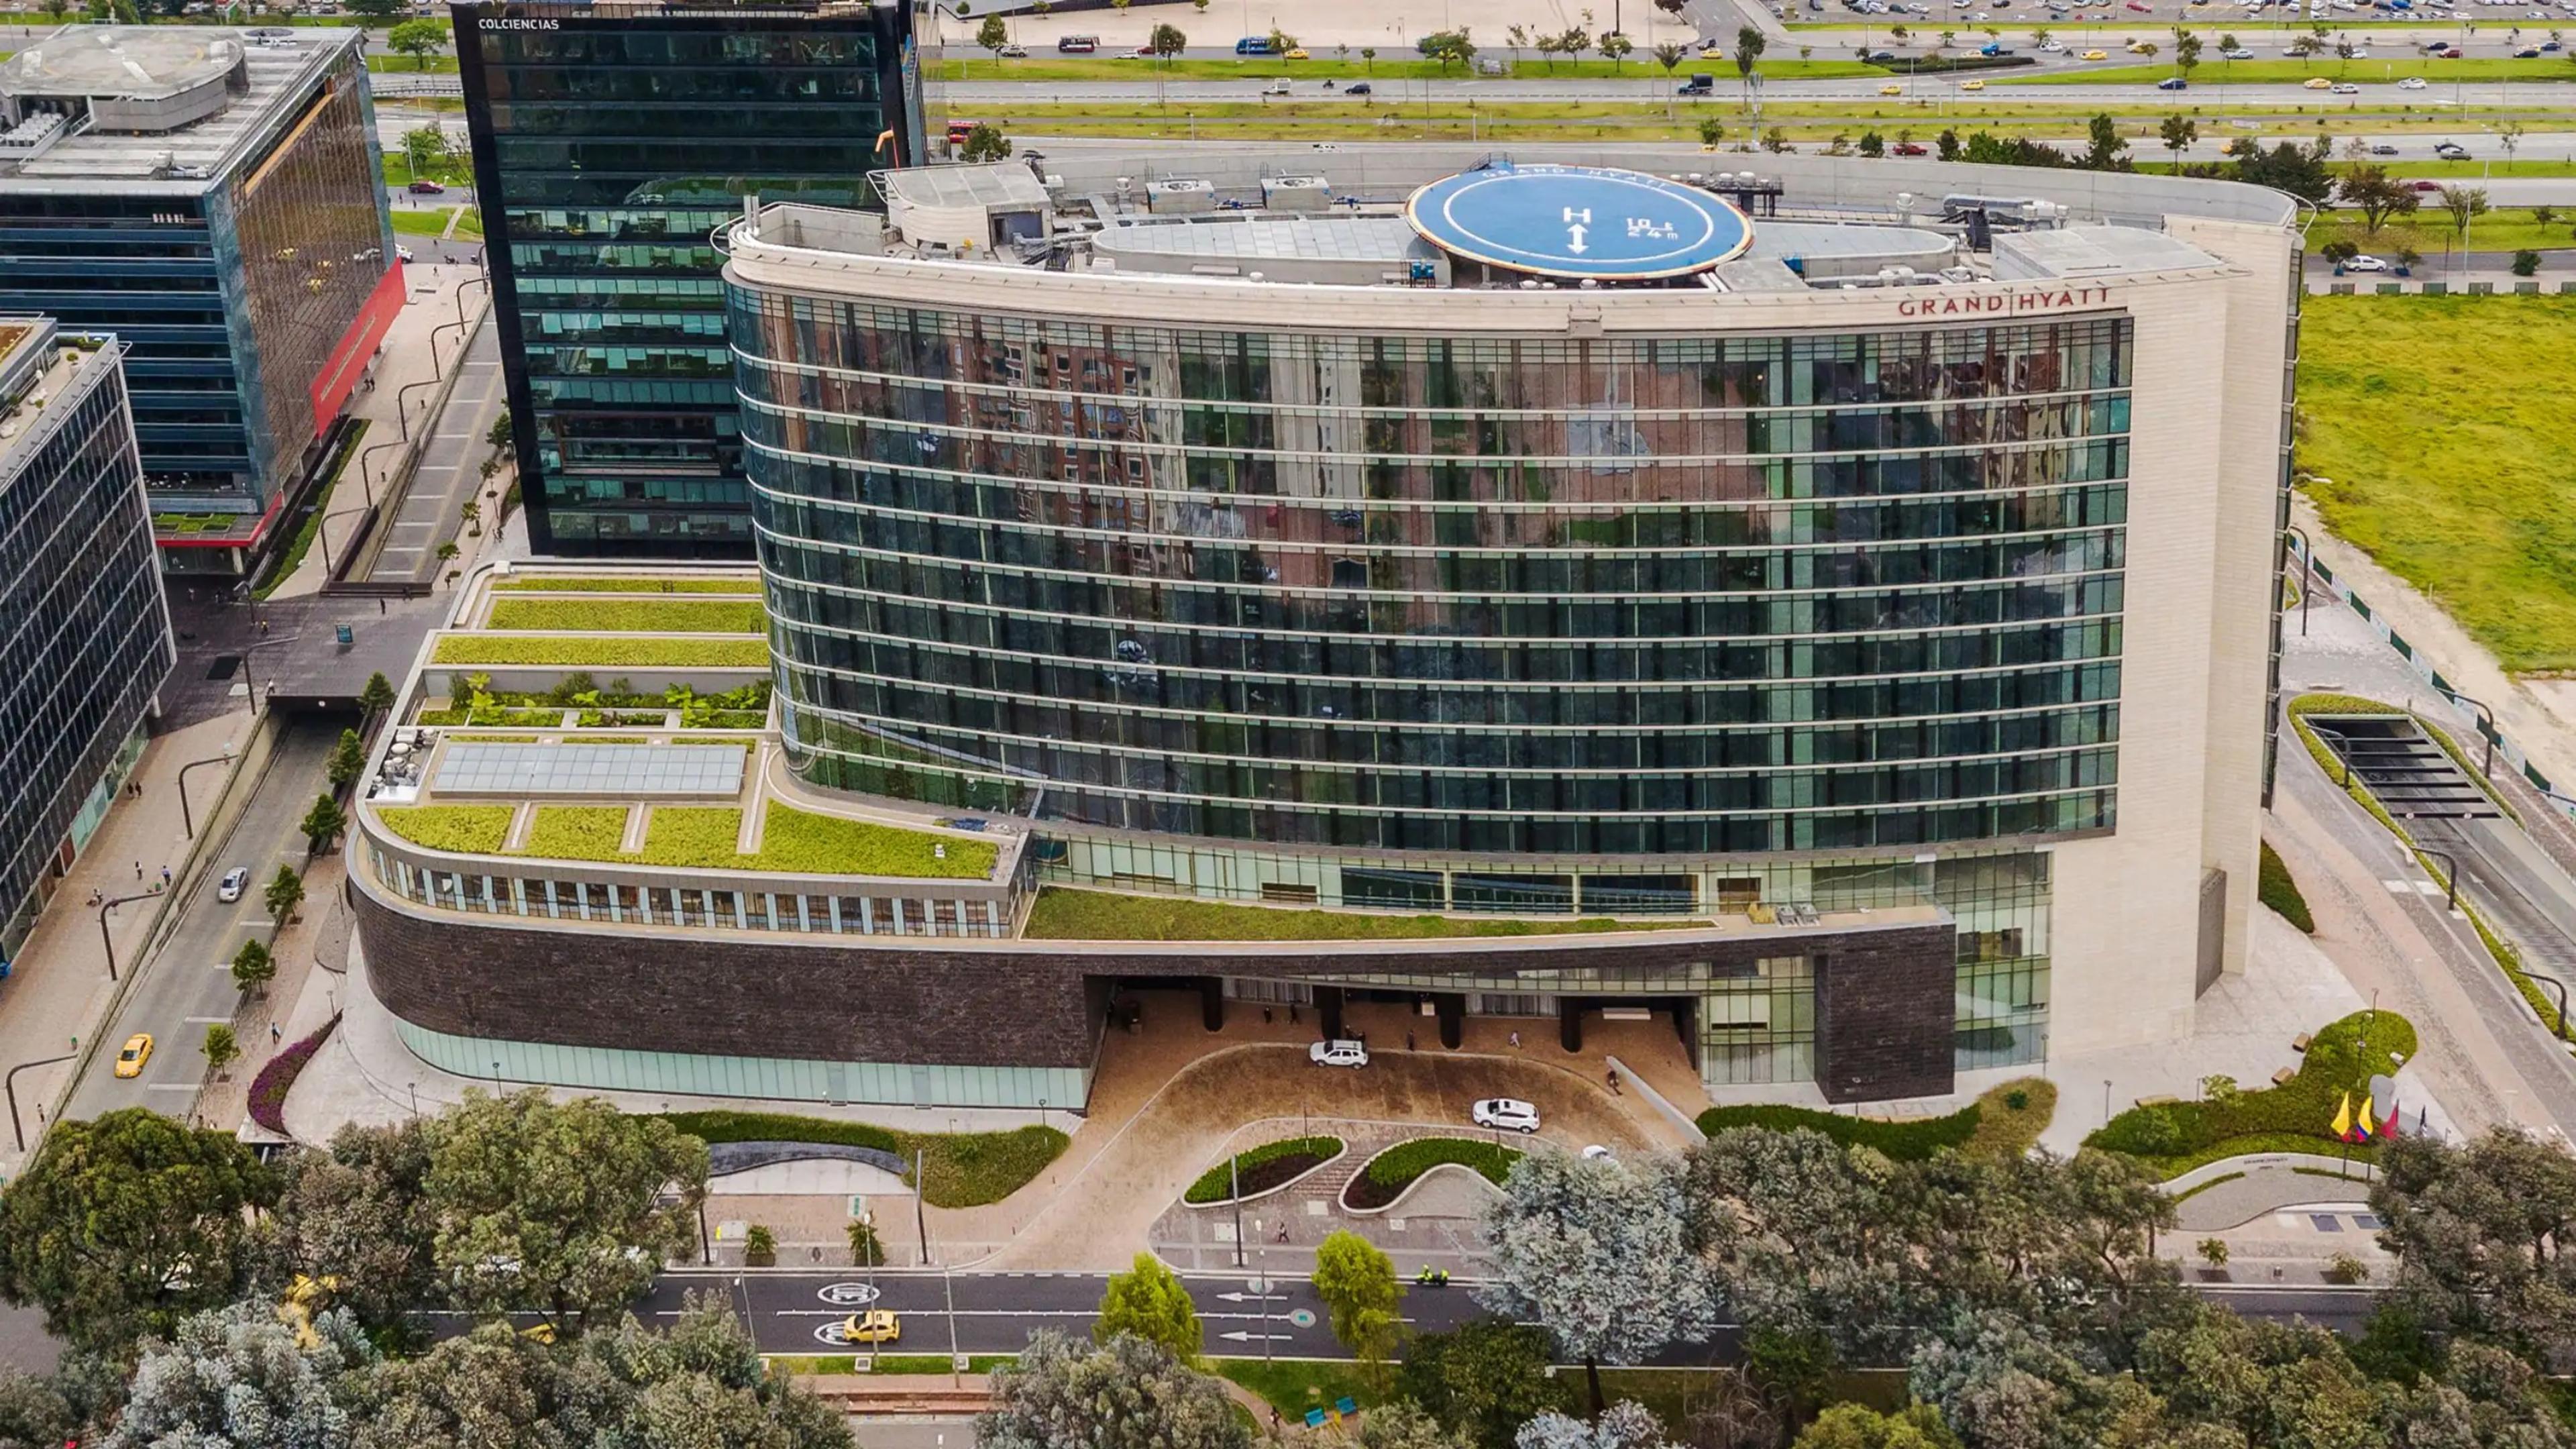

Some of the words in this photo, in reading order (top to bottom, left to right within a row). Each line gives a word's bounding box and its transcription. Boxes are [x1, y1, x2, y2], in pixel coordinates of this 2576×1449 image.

[478, 18, 559, 30] COLCIENCIAS
[1563, 207, 1591, 223] H
[1898, 295, 2004, 315] GRAND
[2019, 288, 2112, 310] HYATT
